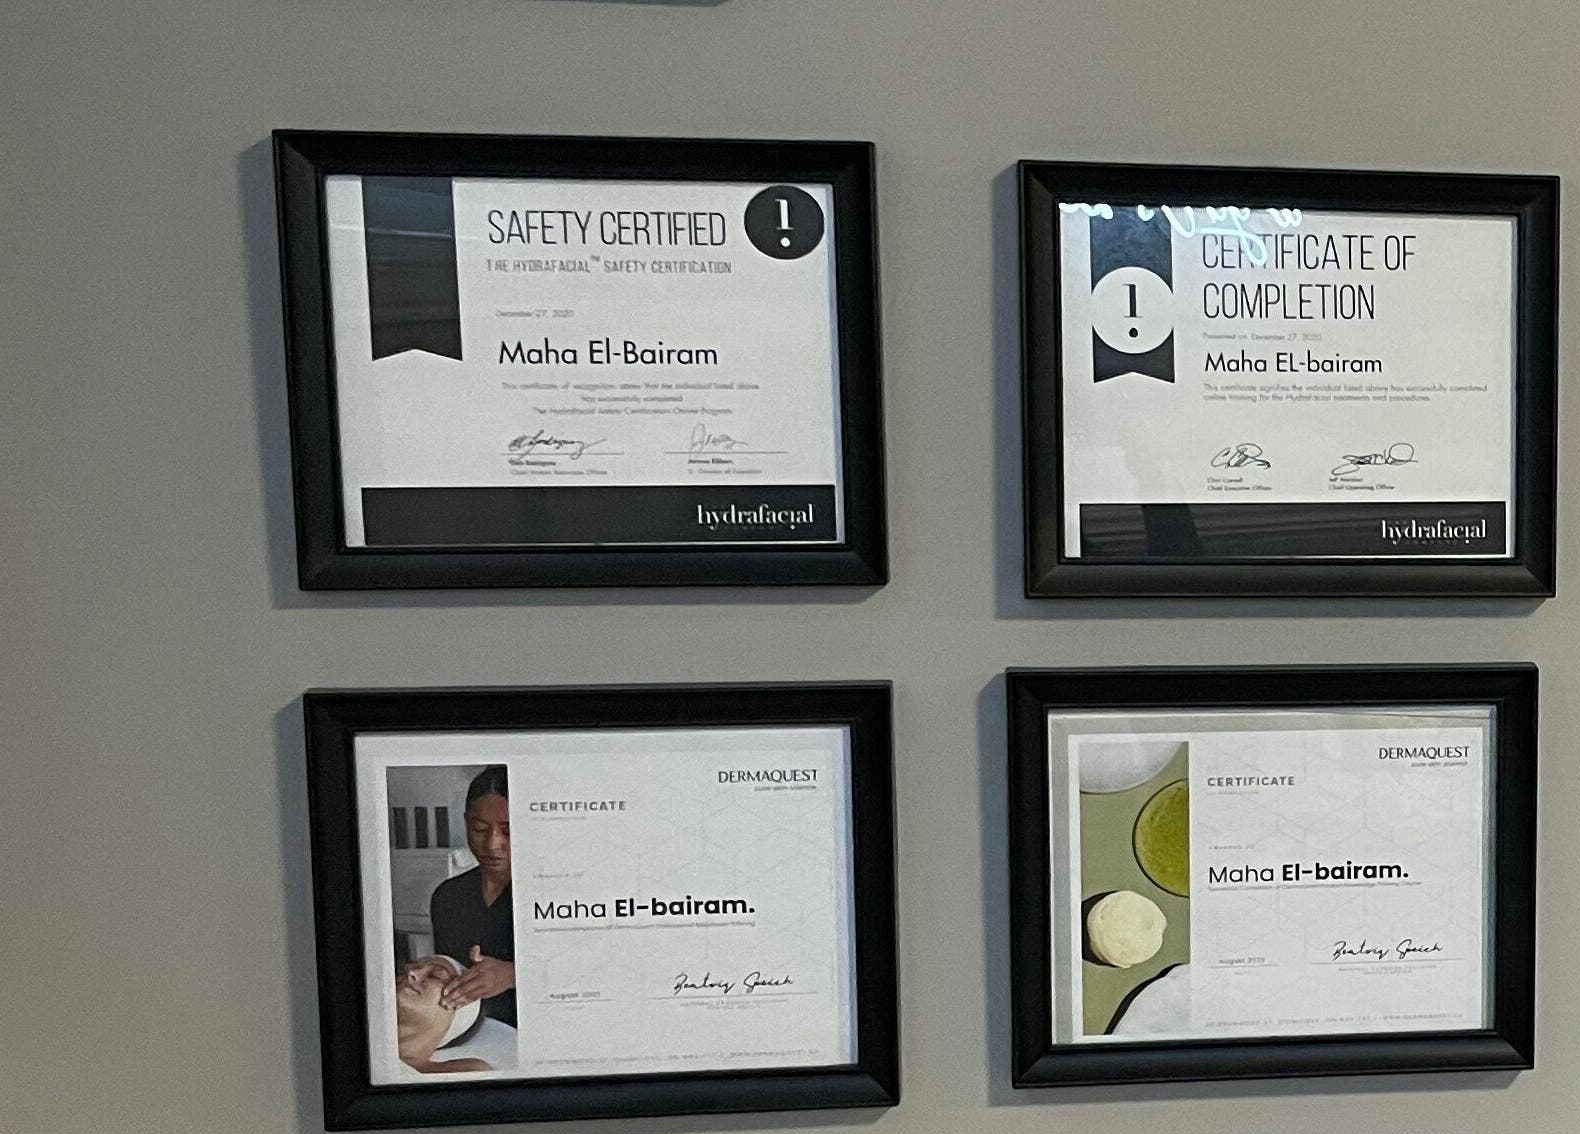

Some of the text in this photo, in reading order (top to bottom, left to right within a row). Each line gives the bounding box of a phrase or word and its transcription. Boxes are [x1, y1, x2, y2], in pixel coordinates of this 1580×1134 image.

[487, 210, 727, 246] SAFETY CERTIFIED
[1202, 233, 1417, 271] CERTIFICATE OF
[486, 258, 509, 273] THE
[604, 260, 646, 274] SAFETY
[651, 260, 732, 274] CERTIFICATION
[1202, 282, 1375, 320] COMPLETION
[499, 337, 718, 366] Maha El-Bairam
[1204, 349, 1383, 374] Maha EL-bairam
[697, 503, 814, 531] hydrafacial
[1381, 519, 1487, 544] hydrafacial
[1378, 746, 1470, 760] DERMAQUEST
[717, 769, 818, 784] DERMAQUEST
[1207, 776, 1295, 787] CERTIFICATE
[529, 800, 627, 812] CERTIFICATE
[1208, 860, 1409, 884] Maha El-bairam.
[533, 895, 755, 920] Maha El-bairam.
